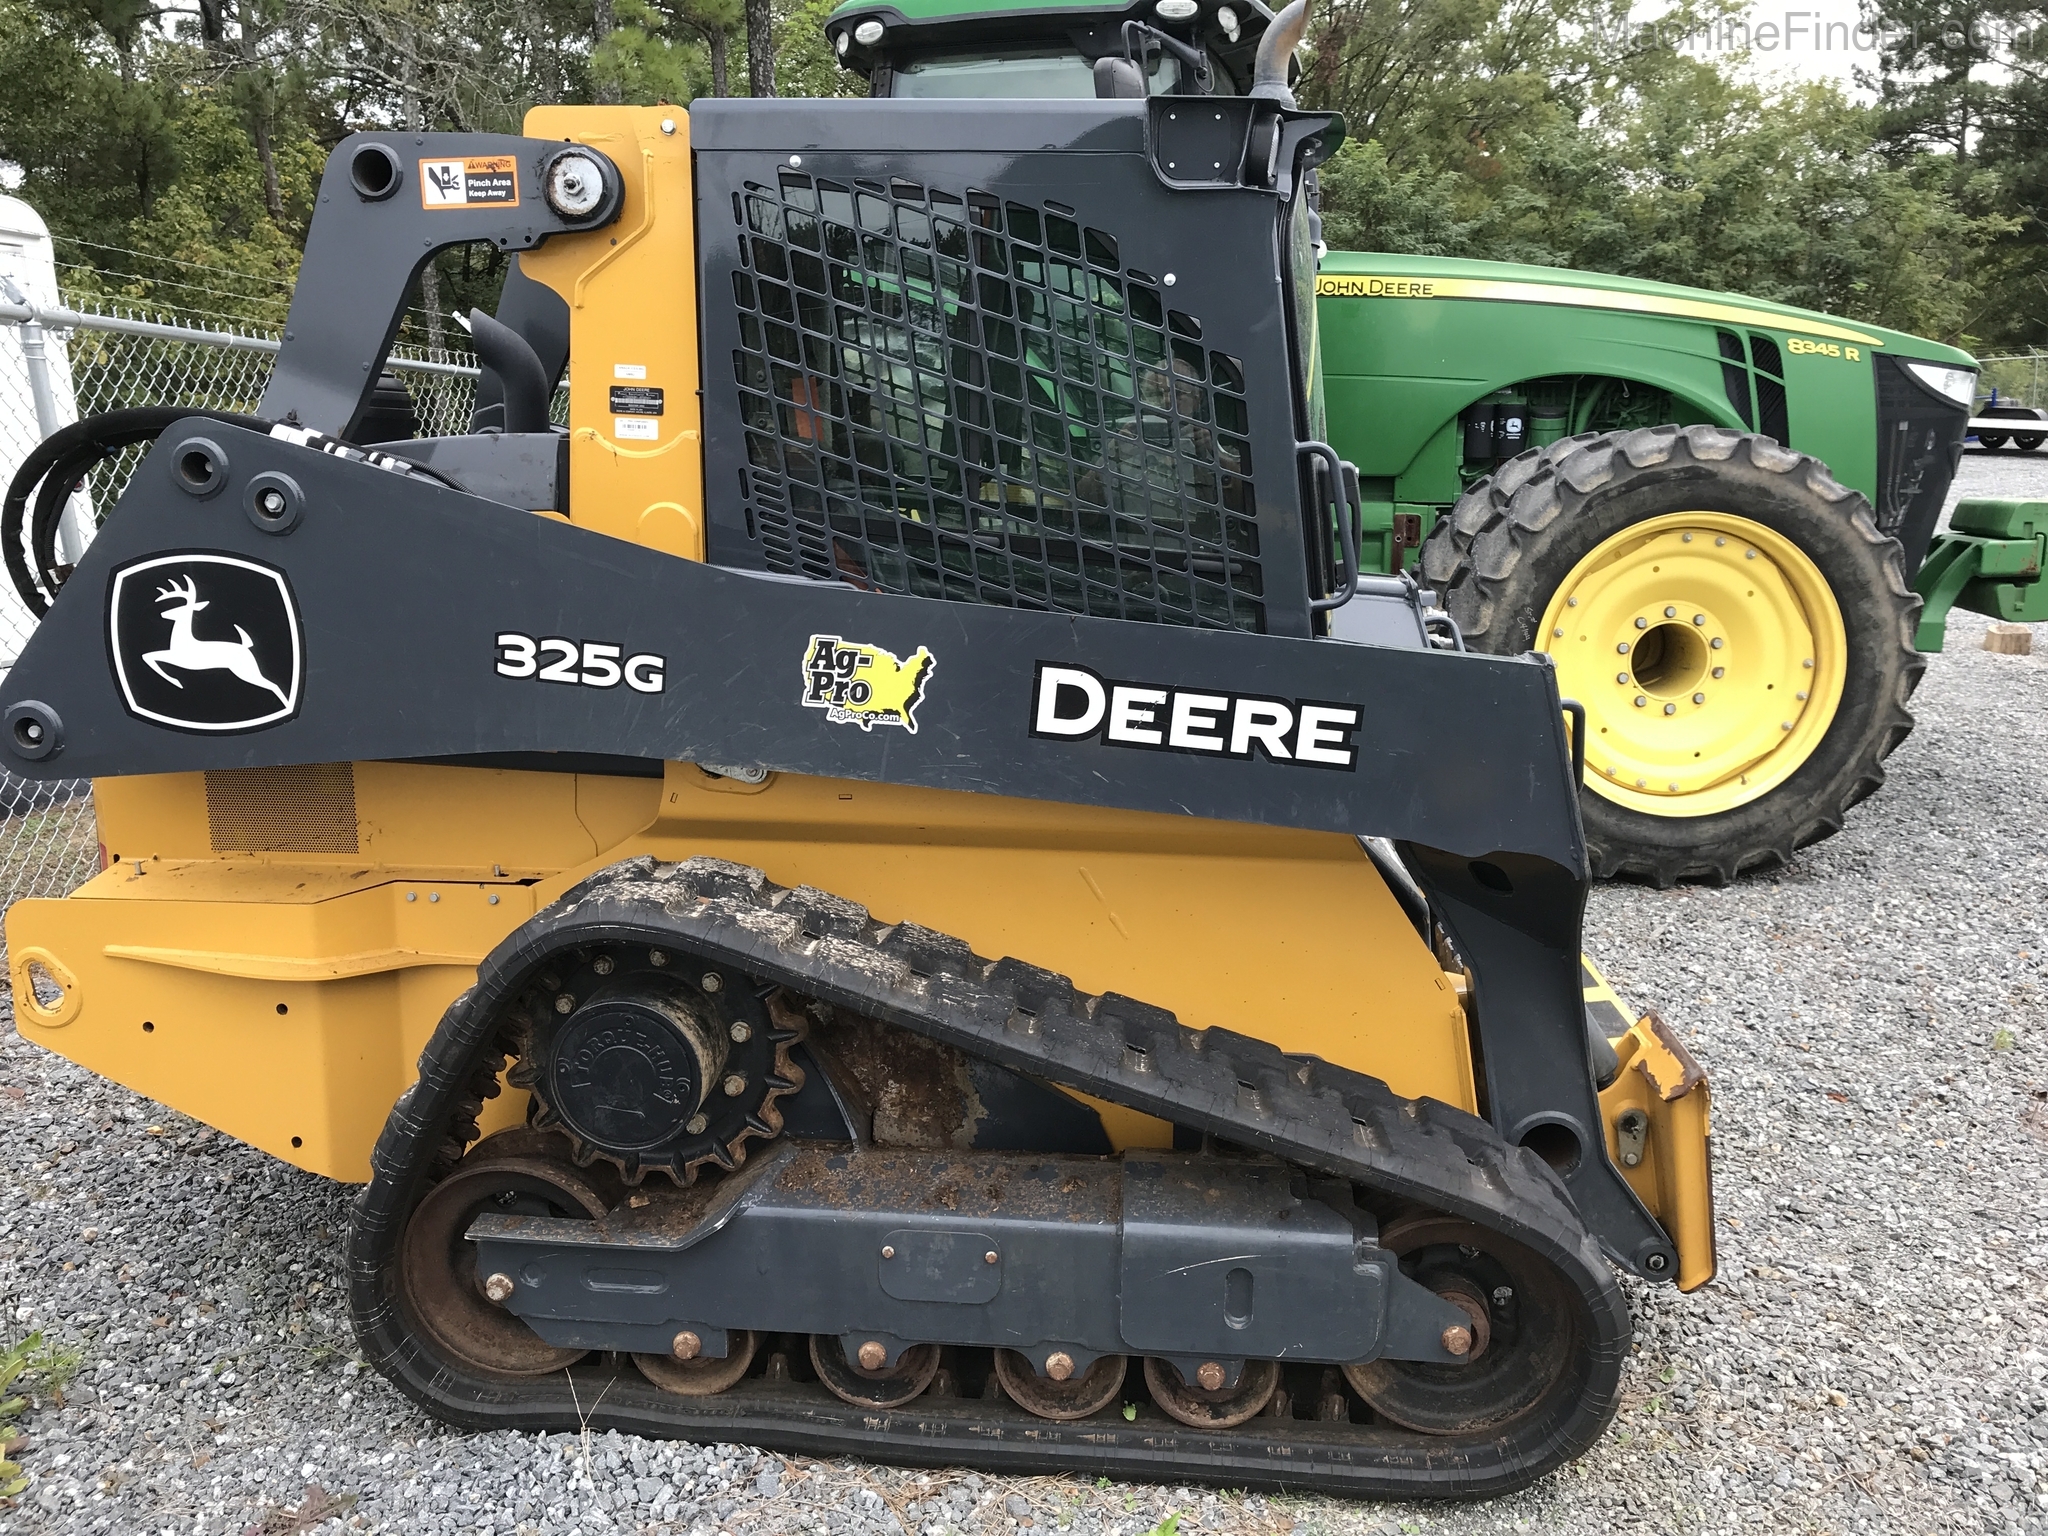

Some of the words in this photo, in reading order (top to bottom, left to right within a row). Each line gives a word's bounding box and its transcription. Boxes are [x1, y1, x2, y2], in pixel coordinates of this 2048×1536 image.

[475, 160, 511, 170] WARNING
[467, 178, 491, 187] Pinch
[492, 178, 511, 186] Area
[468, 190, 486, 198] Keep
[487, 189, 506, 197] Away
[1315, 278, 1364, 293] JOHN
[1369, 279, 1433, 295] DEERE
[1787, 338, 1841, 358] 8345
[1844, 346, 1861, 362] R
[497, 634, 664, 693] 325G
[809, 640, 871, 679] Ag-
[808, 671, 870, 703] Pro
[830, 708, 900, 722] AgProCo.com
[1036, 666, 1357, 765] DEERE
